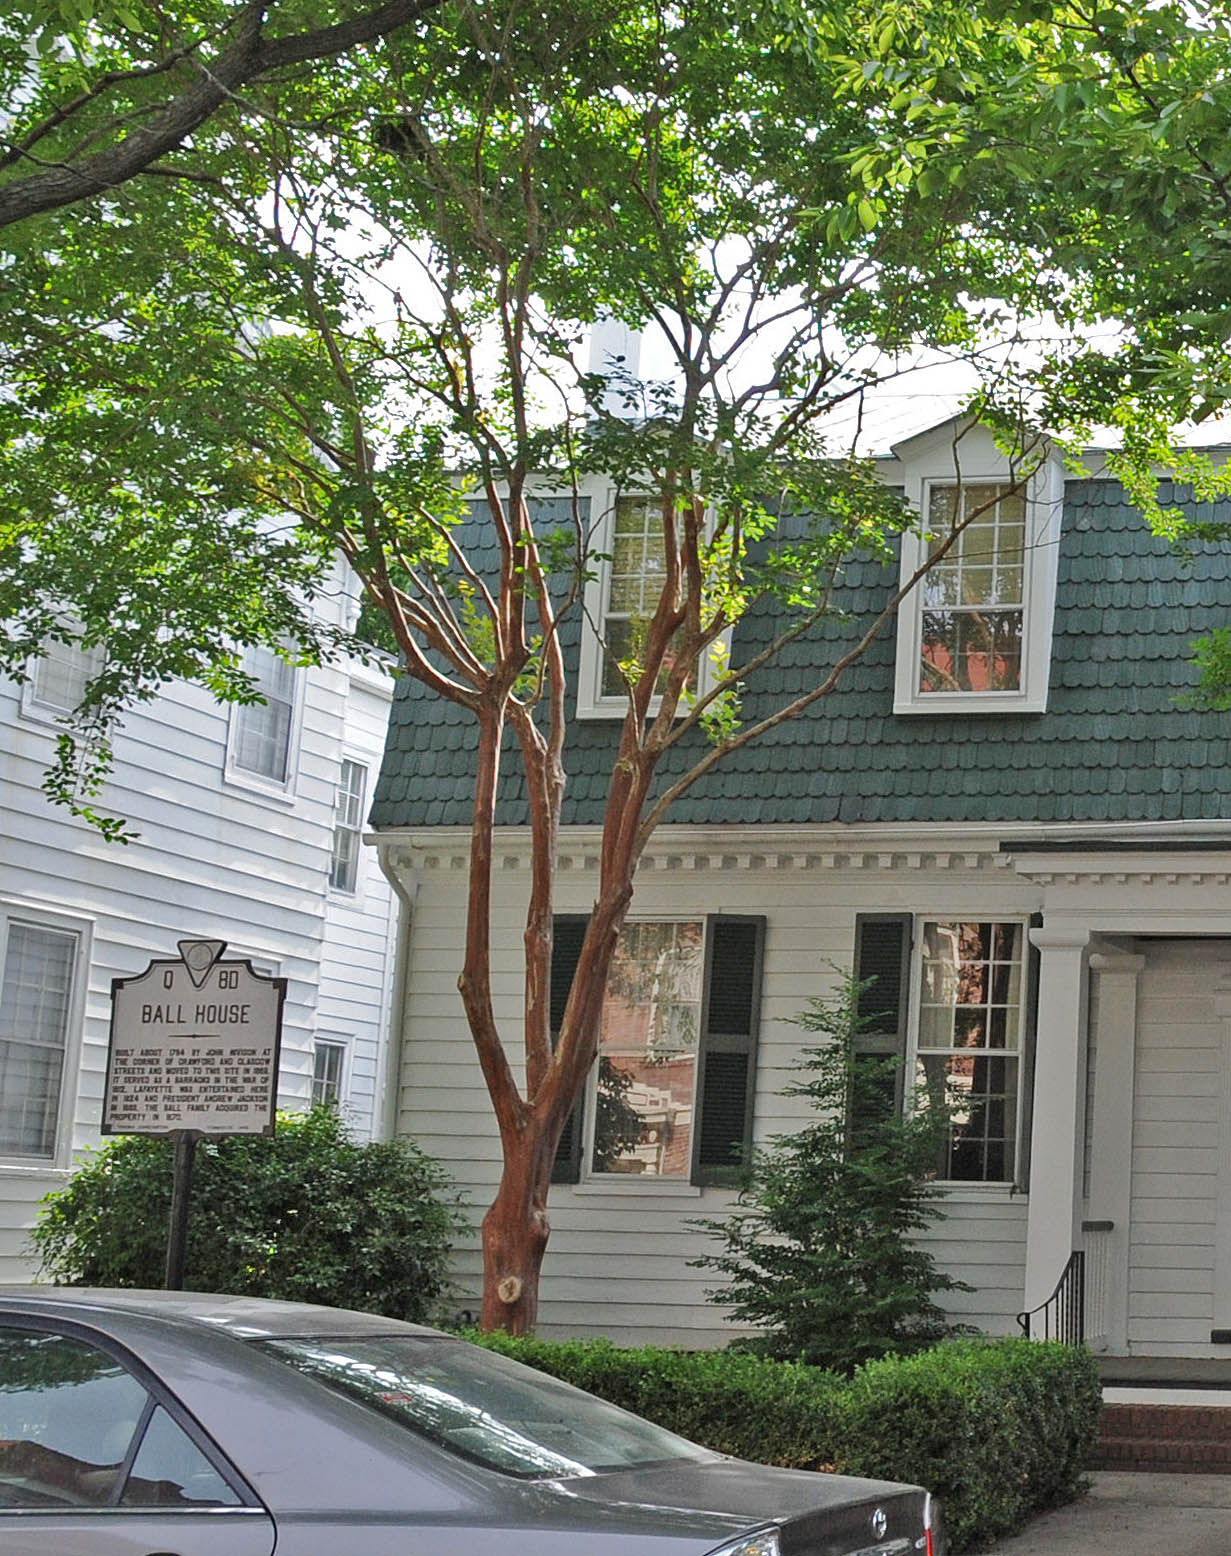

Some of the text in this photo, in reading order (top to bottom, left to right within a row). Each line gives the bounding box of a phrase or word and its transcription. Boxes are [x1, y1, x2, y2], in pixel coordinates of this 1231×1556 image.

[163, 970, 174, 990] Q
[141, 1004, 252, 1024] BALL HOUSE
[263, 1048, 272, 1056] AT
[114, 1067, 145, 1075] STREETS
[149, 1067, 162, 1075] AND
[166, 1067, 189, 1075] MOVED
[193, 1067, 201, 1075] TO
[205, 1067, 220, 1075] THIS
[224, 1067, 239, 1075] SITE
[113, 1076, 120, 1084] IT
[124, 1076, 150, 1084] SERVED
[175, 1076, 210, 1084] BARRACKS
[225, 1076, 238, 1084] THE
[260, 1076, 269, 1084] OF
[134, 1085, 172, 1093] LAFAYETTE
[199, 1085, 245, 1093] ENTERTAINED
[250, 1085, 268, 1093] HERE
[110, 1113, 145, 1121] PROPERTY
